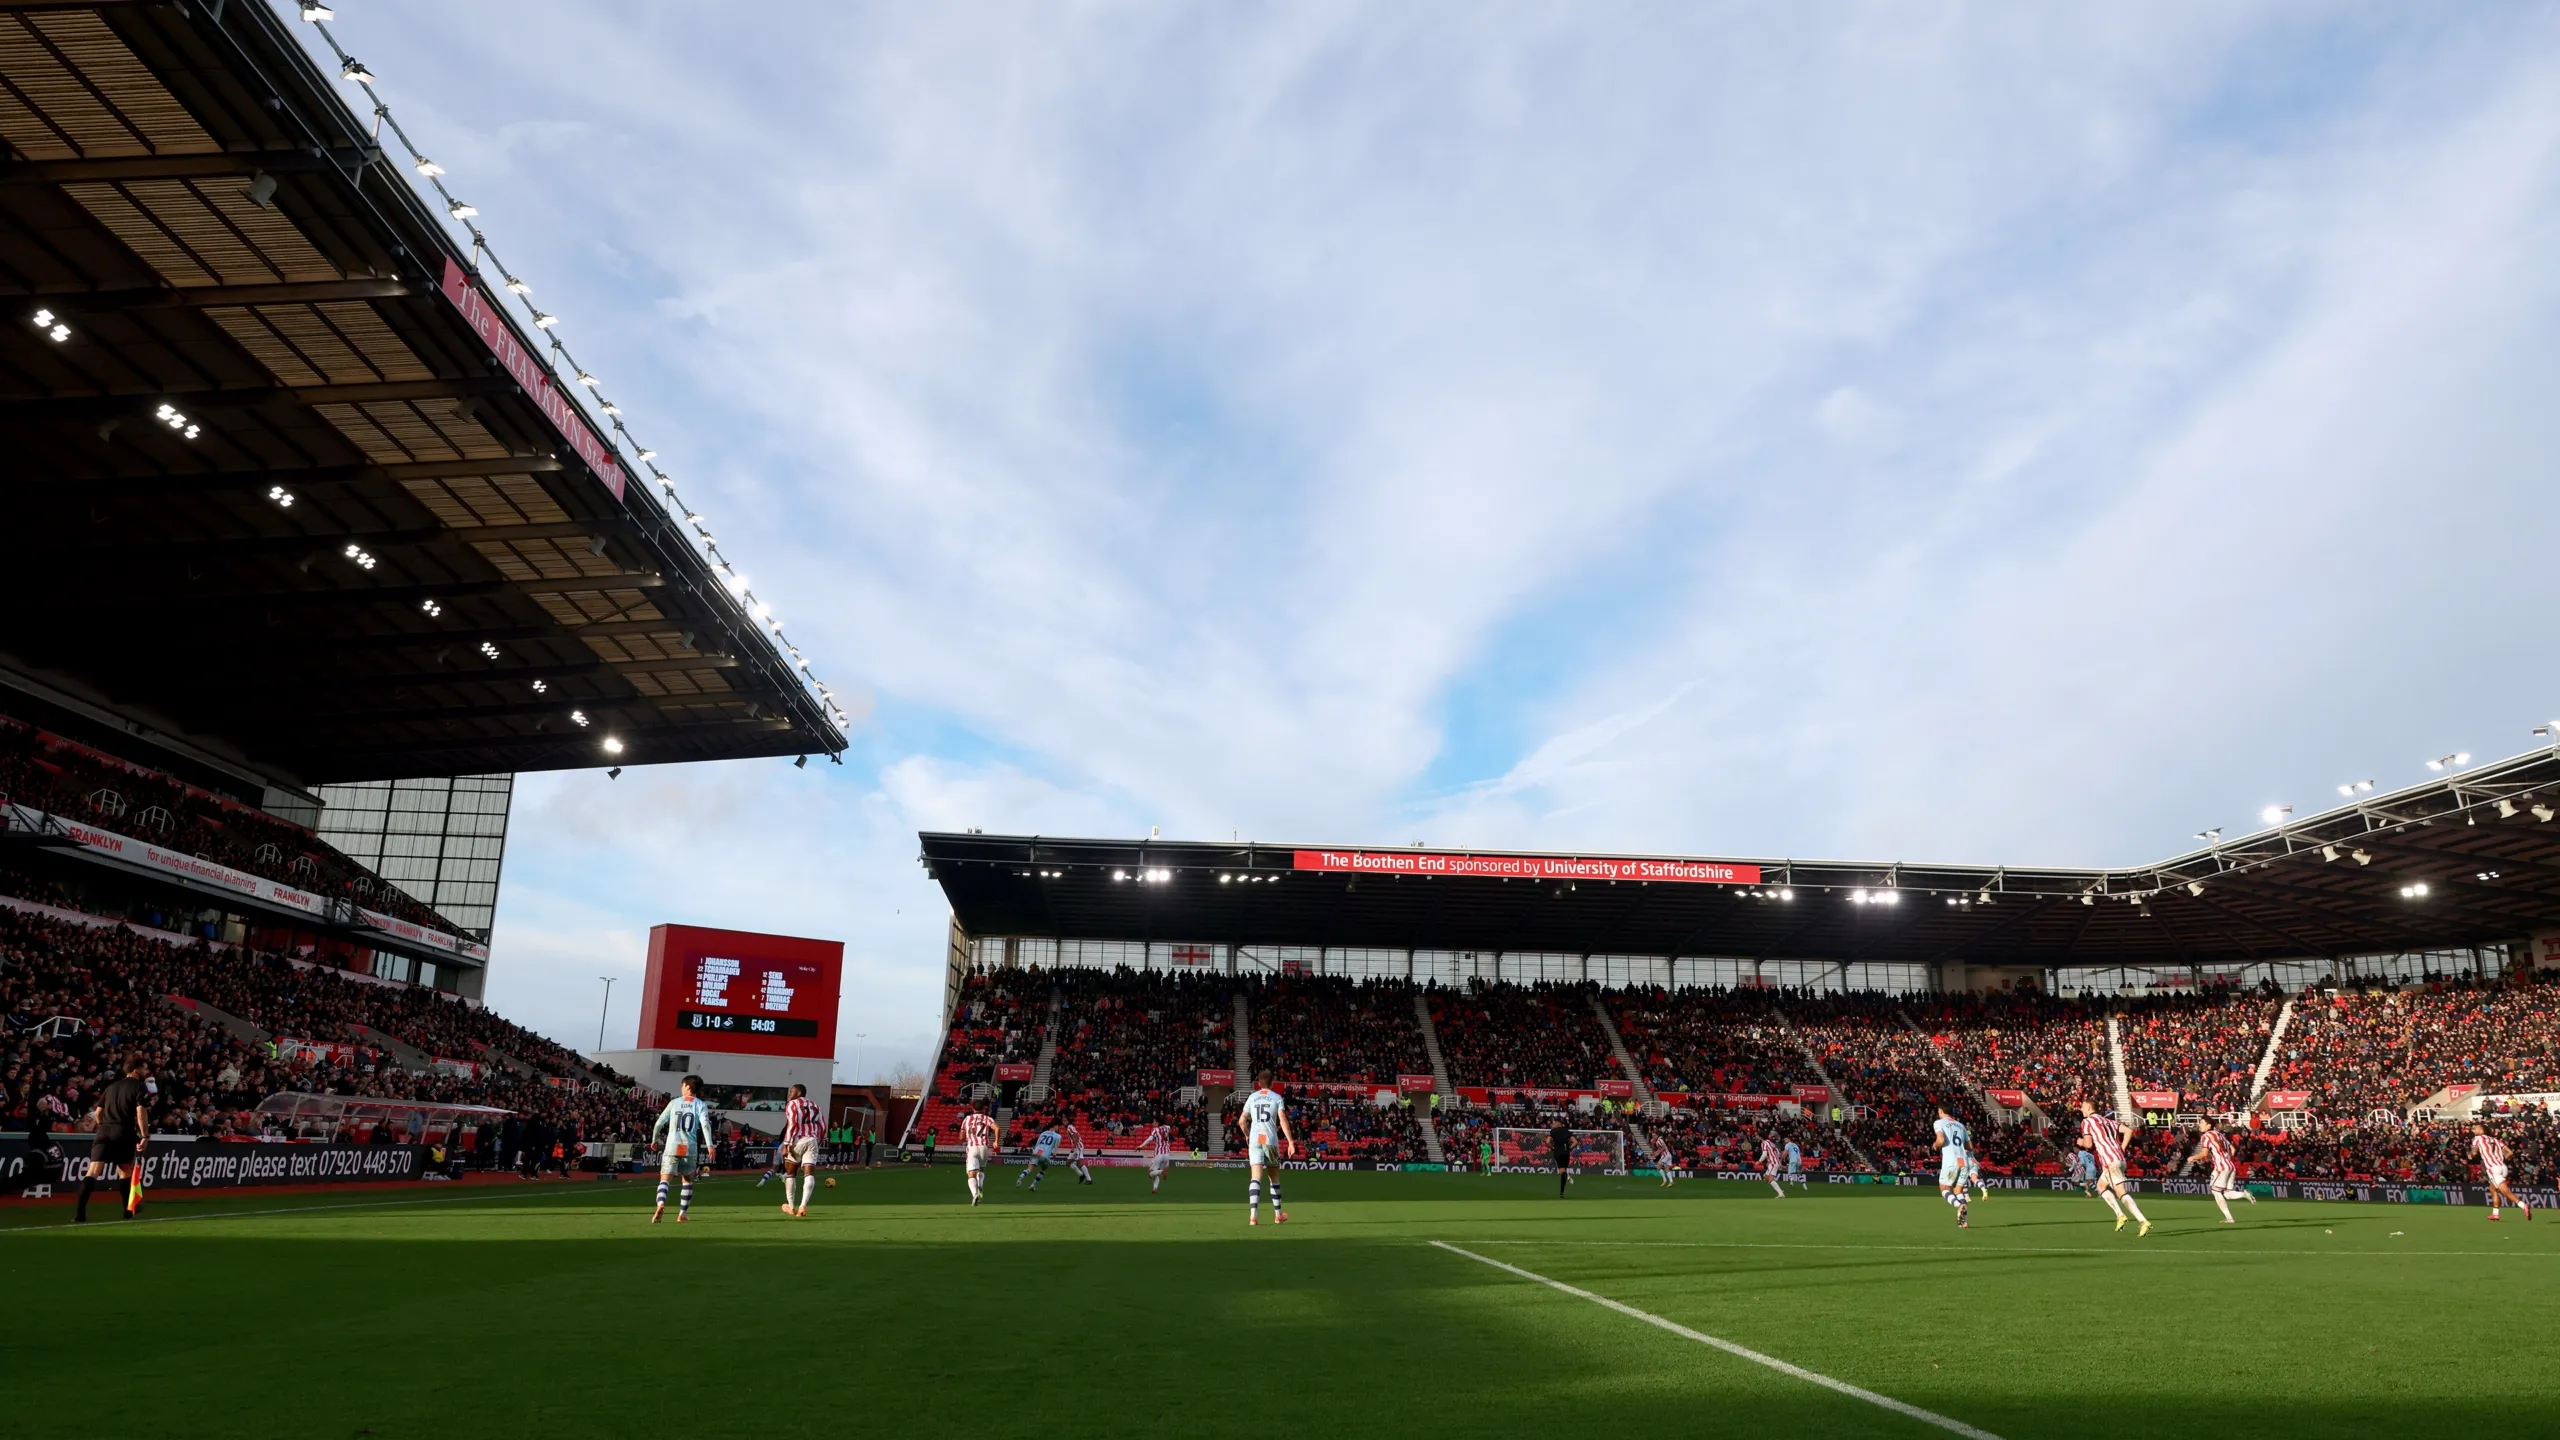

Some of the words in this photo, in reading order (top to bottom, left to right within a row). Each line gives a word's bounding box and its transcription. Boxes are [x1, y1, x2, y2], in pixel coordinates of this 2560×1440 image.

[458, 277, 489, 337] The
[495, 324, 581, 447] FRANKLYN
[585, 436, 618, 491] Stand
[66, 826, 123, 852] FRANKLYN
[146, 848, 160, 861] for
[160, 855, 189, 871] unique
[191, 861, 223, 881] financial
[224, 872, 257, 893] planning
[273, 887, 310, 906] FRANKLYN
[1322, 853, 1348, 867] The
[1353, 855, 1414, 869] Boothen
[1419, 857, 1445, 870] End
[1449, 859, 1519, 873] sponsored
[1523, 860, 1540, 876] by
[1544, 860, 1617, 877] University
[1622, 862, 1637, 875] of
[1640, 863, 1733, 880] Staffordshire
[395, 924, 423, 939] FRANKLYN
[428, 933, 453, 948] FRANKLYN
[751, 1018, 776, 1032] 54:03
[1000, 1067, 1009, 1076] 19
[1200, 1072, 1211, 1081] 20
[1401, 1078, 1409, 1086] 21
[1599, 1083, 1609, 1091] 22
[2136, 1095, 2147, 1103] 25
[2272, 1095, 2284, 1103] 26
[2451, 1089, 2459, 1098] 27
[799, 1105, 819, 1125] 22
[1254, 1103, 1271, 1123] 15
[675, 1111, 695, 1132] 10
[1039, 1134, 1053, 1146] 20
[1952, 1130, 1962, 1147] 6
[161, 1149, 189, 1180] the
[191, 1155, 237, 1187] game
[238, 1149, 287, 1185] please
[290, 1152, 318, 1177] text
[319, 1150, 362, 1176] 07920
[363, 1150, 388, 1175] 448
[388, 1150, 412, 1174] 570
[1087, 1158, 1107, 1167] pink
